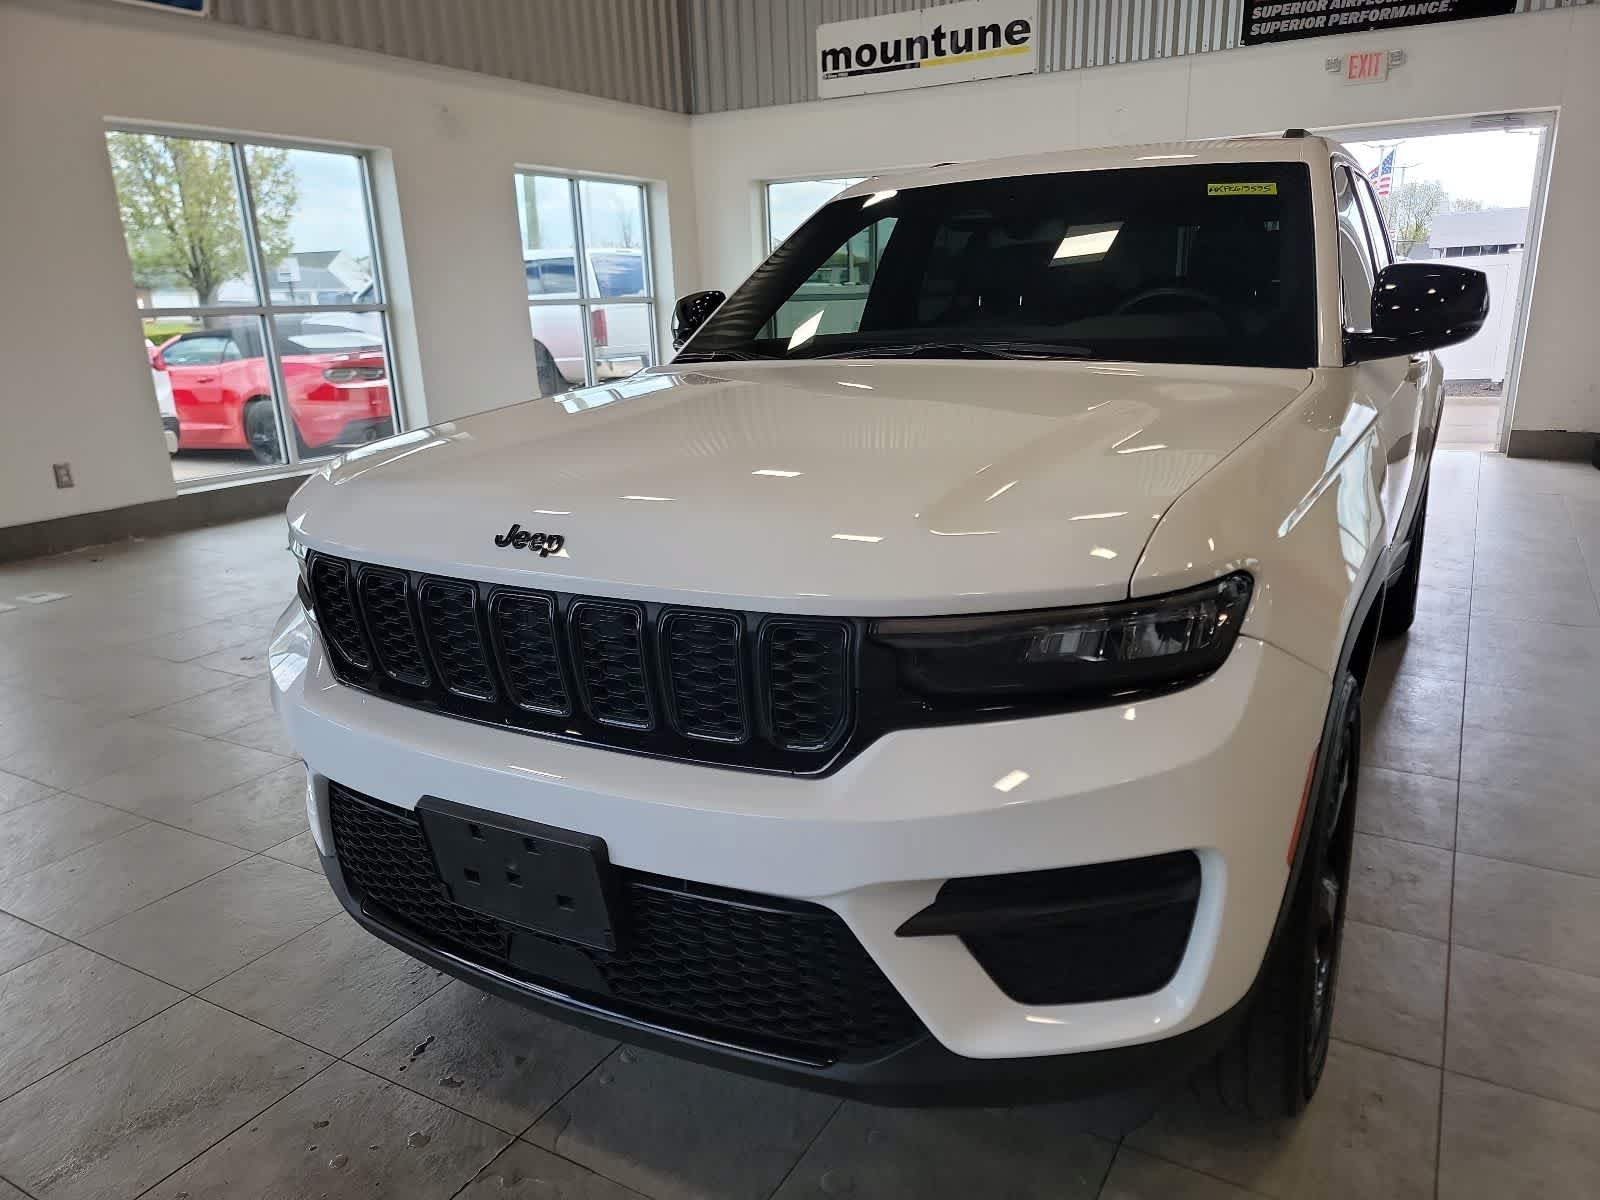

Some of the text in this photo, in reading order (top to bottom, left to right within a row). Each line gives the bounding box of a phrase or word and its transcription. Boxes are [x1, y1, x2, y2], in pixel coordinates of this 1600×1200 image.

[1250, 0, 1453, 36] SUPERIOR PERFORMANCE.
[1252, 0, 1401, 20] SUPERIOR AIRF
[821, 18, 1032, 73] mountune
[1348, 53, 1383, 80] EXIT
[494, 523, 565, 558] Jeep
